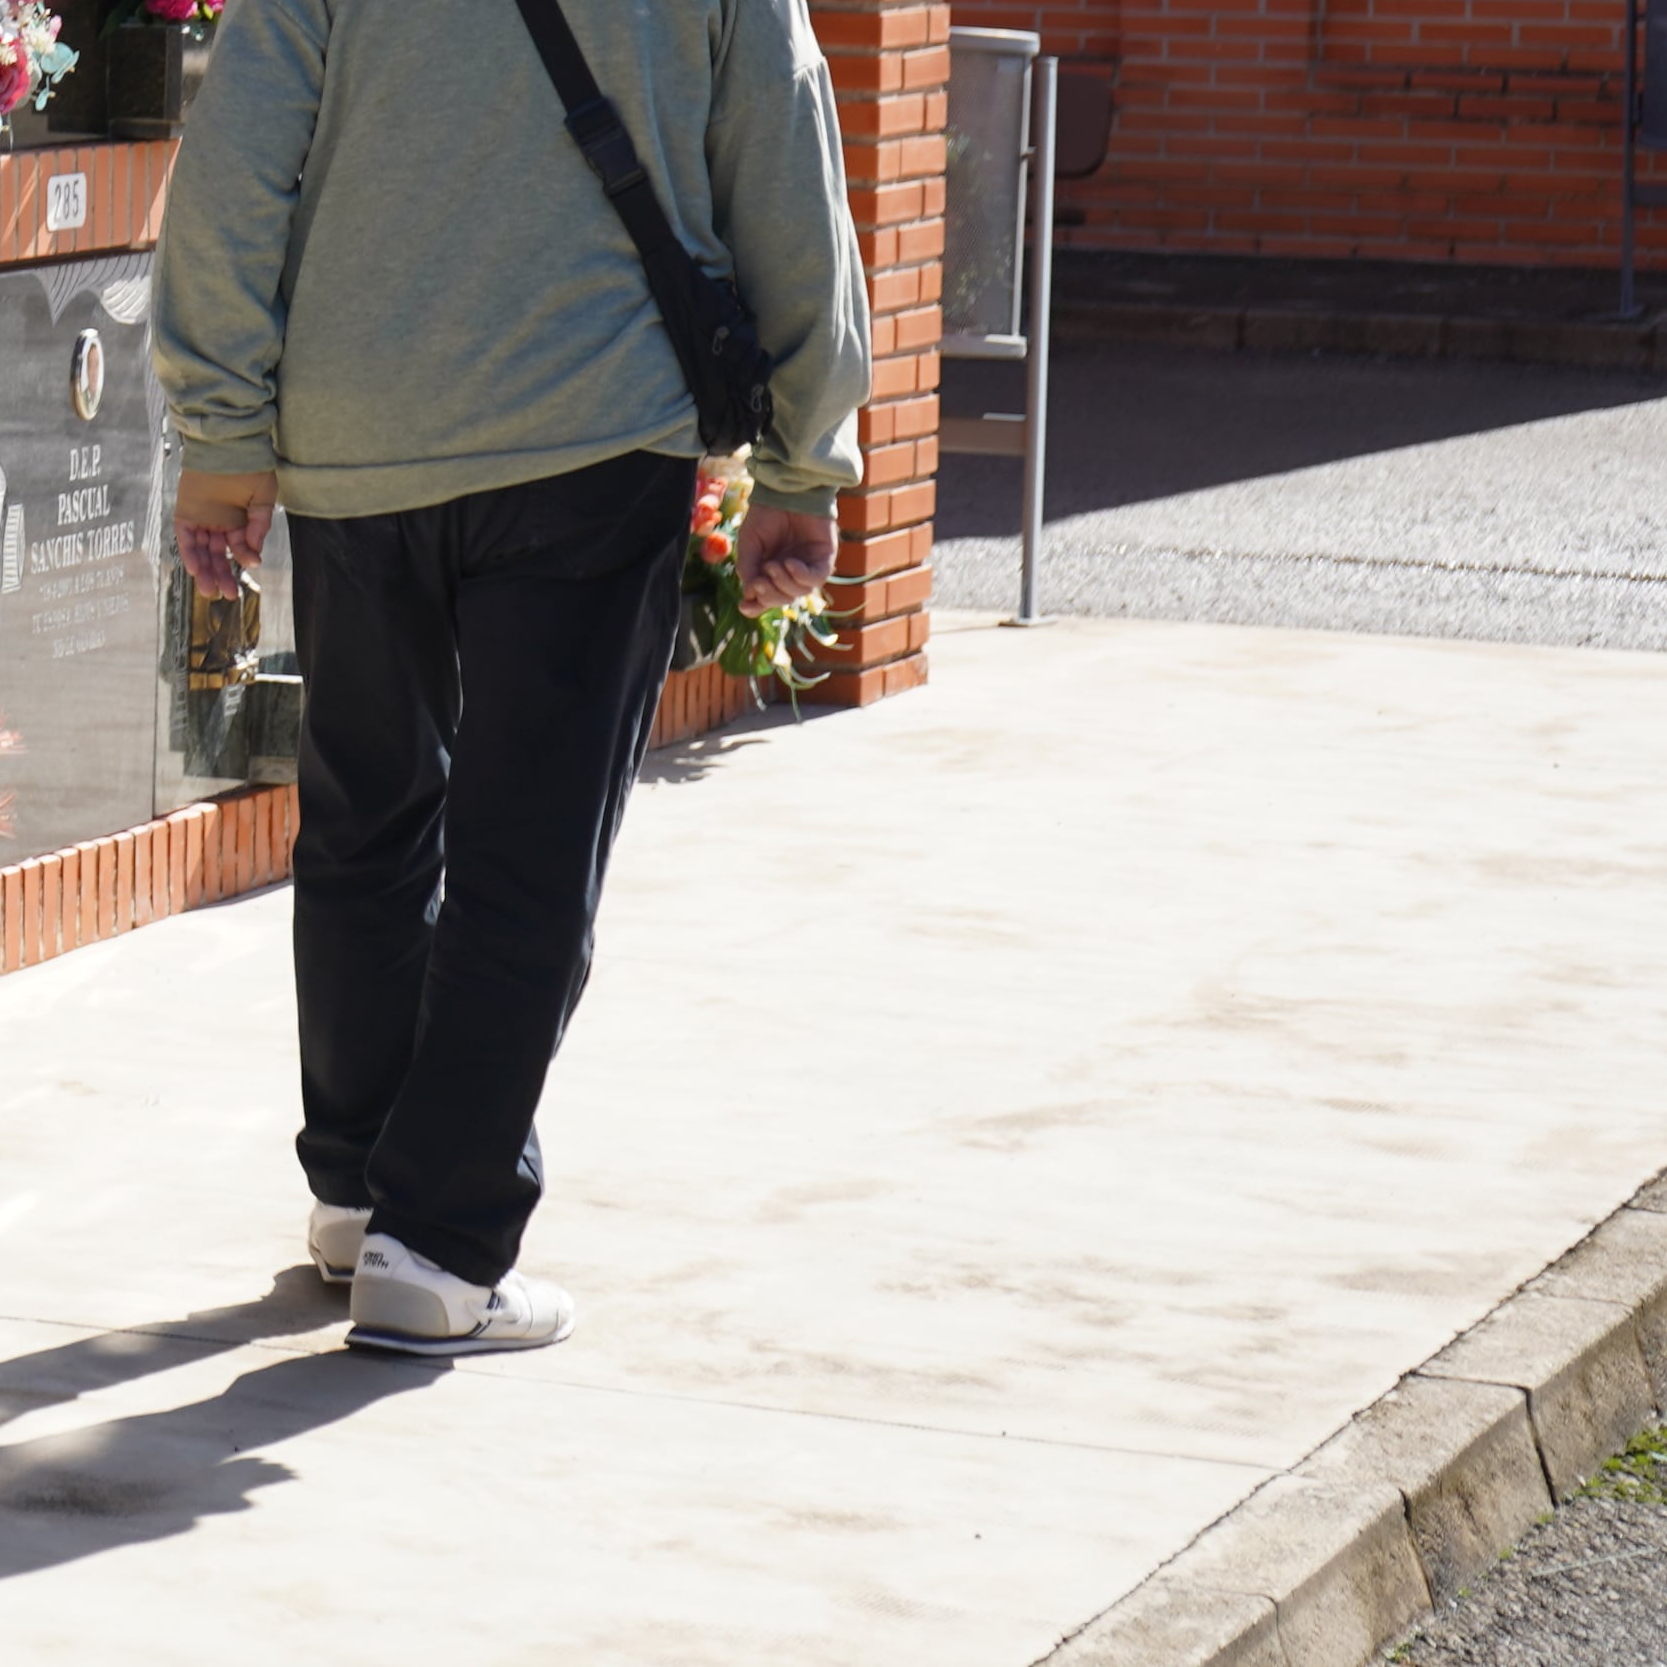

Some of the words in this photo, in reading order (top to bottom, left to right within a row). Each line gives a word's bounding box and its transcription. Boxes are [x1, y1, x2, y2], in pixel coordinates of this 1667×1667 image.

[54, 179, 80, 224] 285
[58, 485, 110, 525] PASCUAL
[31, 532, 83, 574] SANCHIS
[87, 521, 134, 561] TORRES
